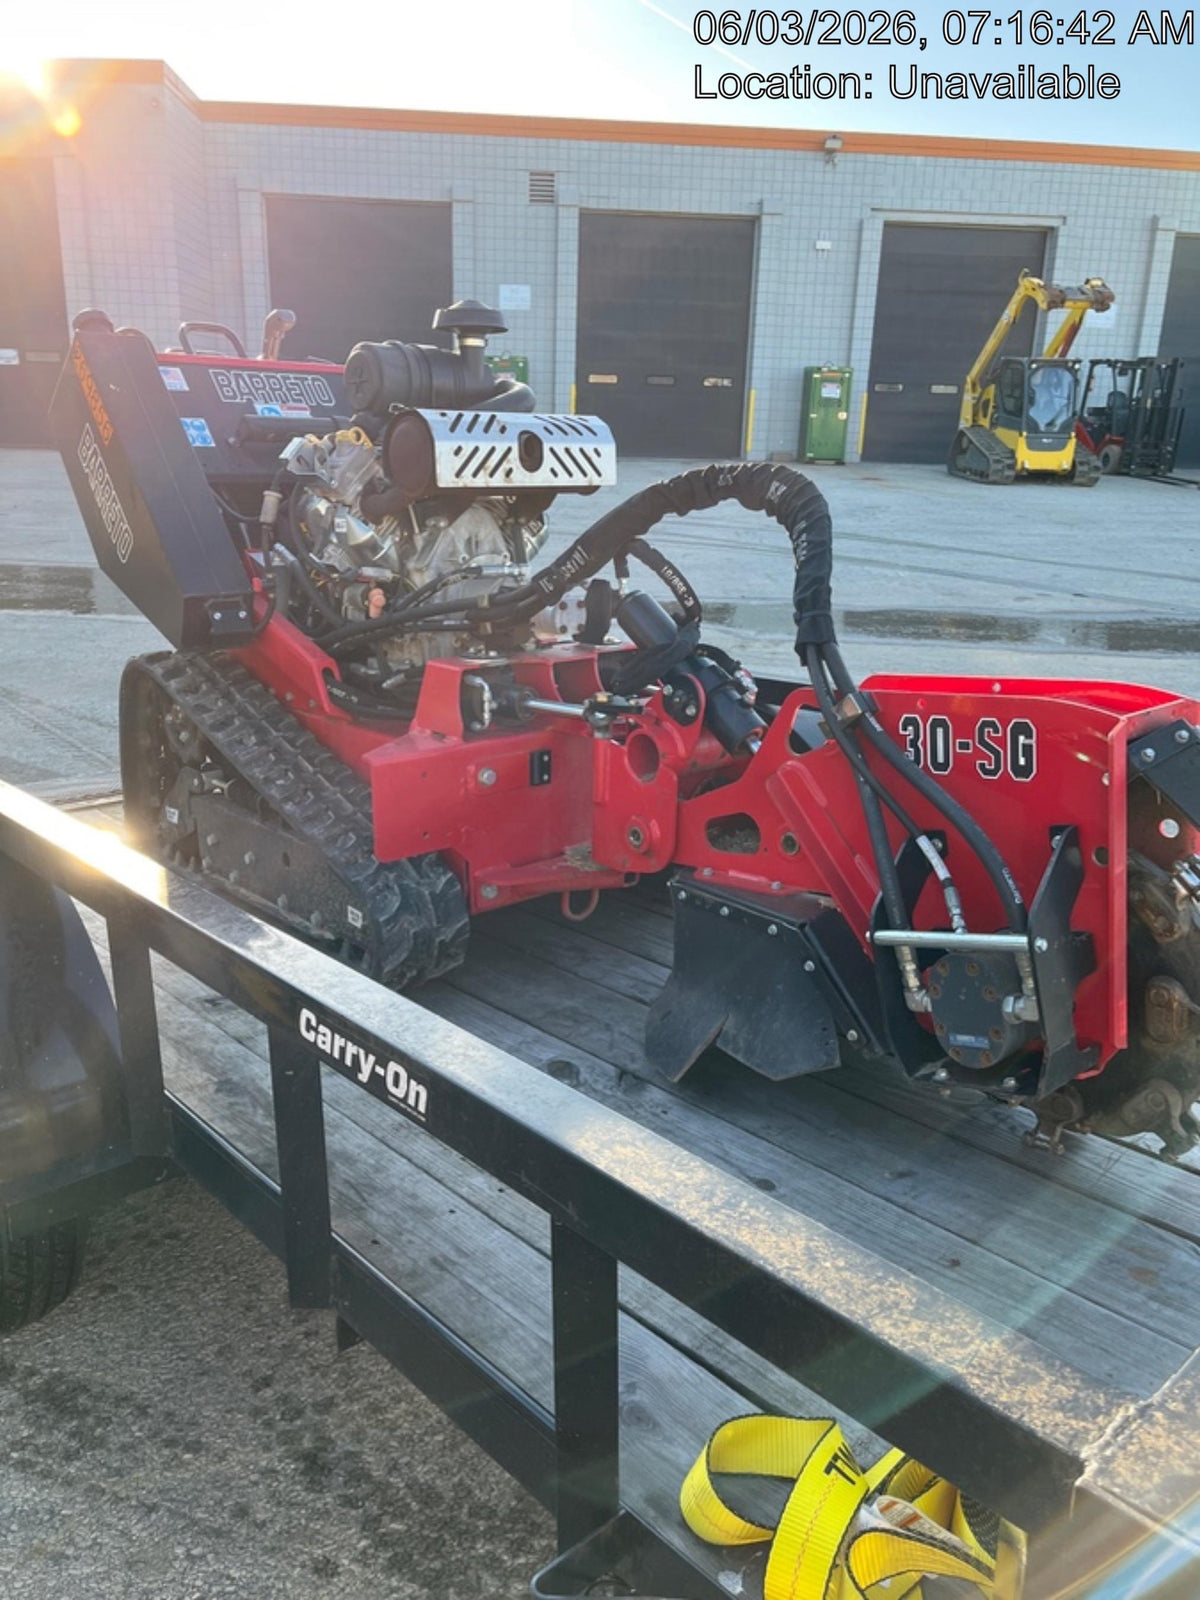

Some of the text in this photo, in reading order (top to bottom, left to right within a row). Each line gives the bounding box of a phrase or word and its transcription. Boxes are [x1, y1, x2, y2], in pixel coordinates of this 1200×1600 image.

[208, 368, 336, 407] BARRETO
[77, 421, 134, 565] BARRETO
[898, 713, 1037, 782] 30-SG
[299, 1007, 428, 1115] Carry-On
